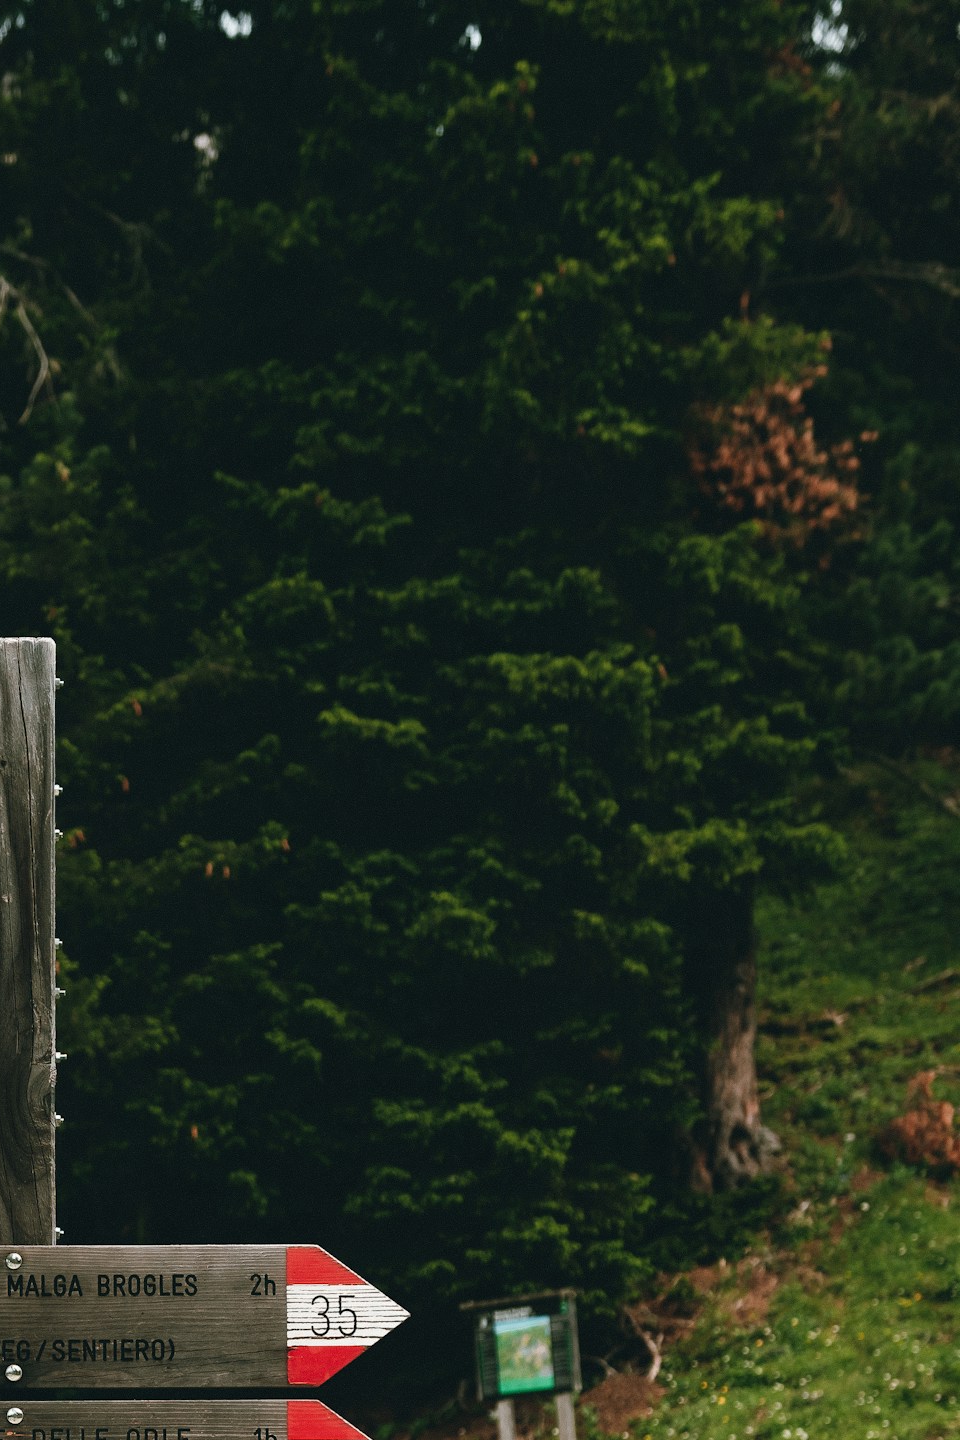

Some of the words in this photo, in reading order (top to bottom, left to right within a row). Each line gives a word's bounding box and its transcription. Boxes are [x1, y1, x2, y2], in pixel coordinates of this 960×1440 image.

[7, 1274, 83, 1297] MALGA
[97, 1273, 198, 1297] BROGLES
[250, 1273, 277, 1297] 2h
[311, 1295, 358, 1337] 35
